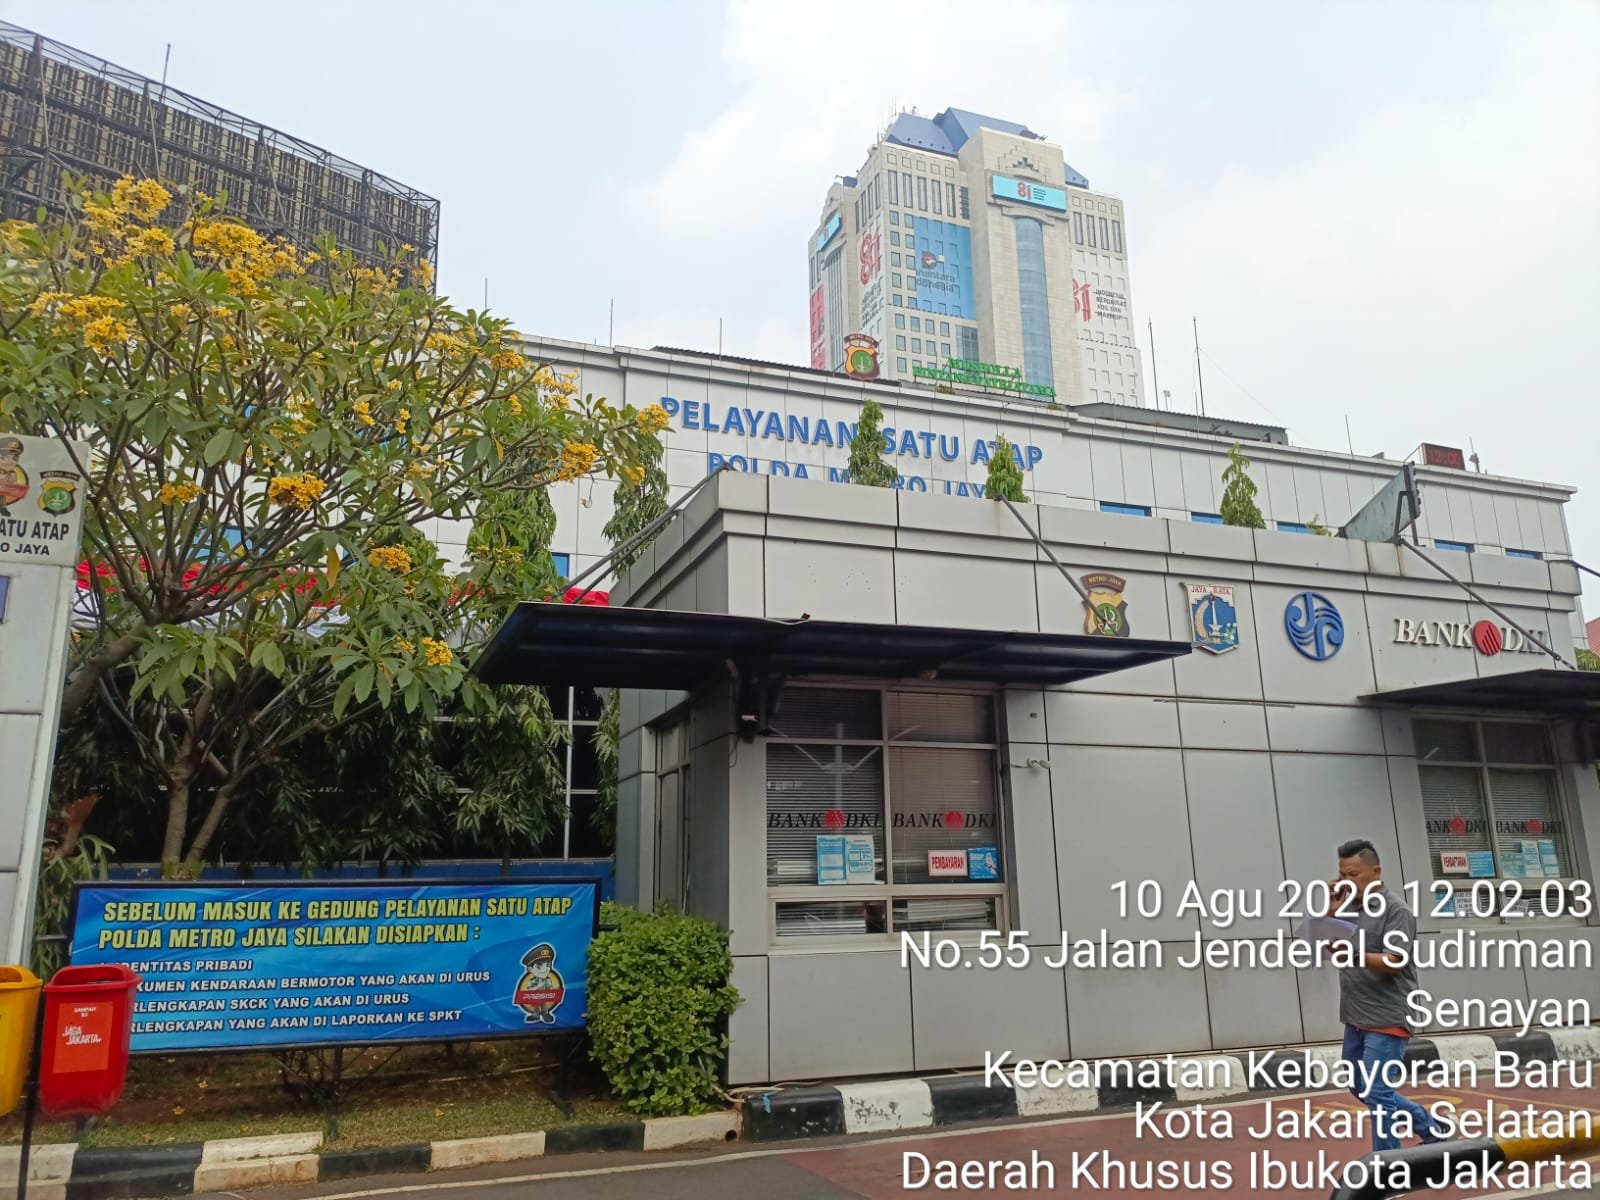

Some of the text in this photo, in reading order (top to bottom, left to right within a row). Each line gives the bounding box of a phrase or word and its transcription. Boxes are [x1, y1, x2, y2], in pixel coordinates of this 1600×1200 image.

[660, 396, 1043, 472] PELAYANAN SATU AAP
[31, 520, 70, 541] ATAP
[14, 543, 50, 556] JAYA
[1395, 617, 1473, 648] BANK
[767, 812, 881, 828] BANK DKI
[893, 812, 995, 829] BANK DKI
[931, 856, 965, 870] PEMBAYARAN
[104, 896, 572, 922] SEBELUM MASUK KE GEDUNG PELAYANAN SATU ATAP
[98, 929, 162, 949] POLDA
[168, 928, 236, 948] METRO
[241, 927, 288, 947] JAYA
[293, 925, 370, 946] SILAKAN
[376, 923, 468, 944] DISIAPKAN
[196, 960, 253, 972] PRIBADI
[190, 978, 276, 992] KENDARAAN
[281, 976, 355, 989] BERMOTOR
[360, 975, 395, 987] YANG
[399, 974, 435, 985] AKAN
[439, 972, 452, 983] DI
[456, 971, 490, 982] URUS
[230, 998, 268, 1011] SKCK
[273, 997, 309, 1009] YANG
[314, 995, 351, 1007] AKAN
[356, 994, 369, 1006] DI
[374, 993, 409, 1005] URUS
[228, 1018, 266, 1030] YANG
[270, 1016, 308, 1028] AKAN
[313, 1015, 327, 1027] DI
[332, 1013, 402, 1025] LAPORKAN
[407, 1012, 424, 1023] KE
[428, 1010, 463, 1022] SPKT
